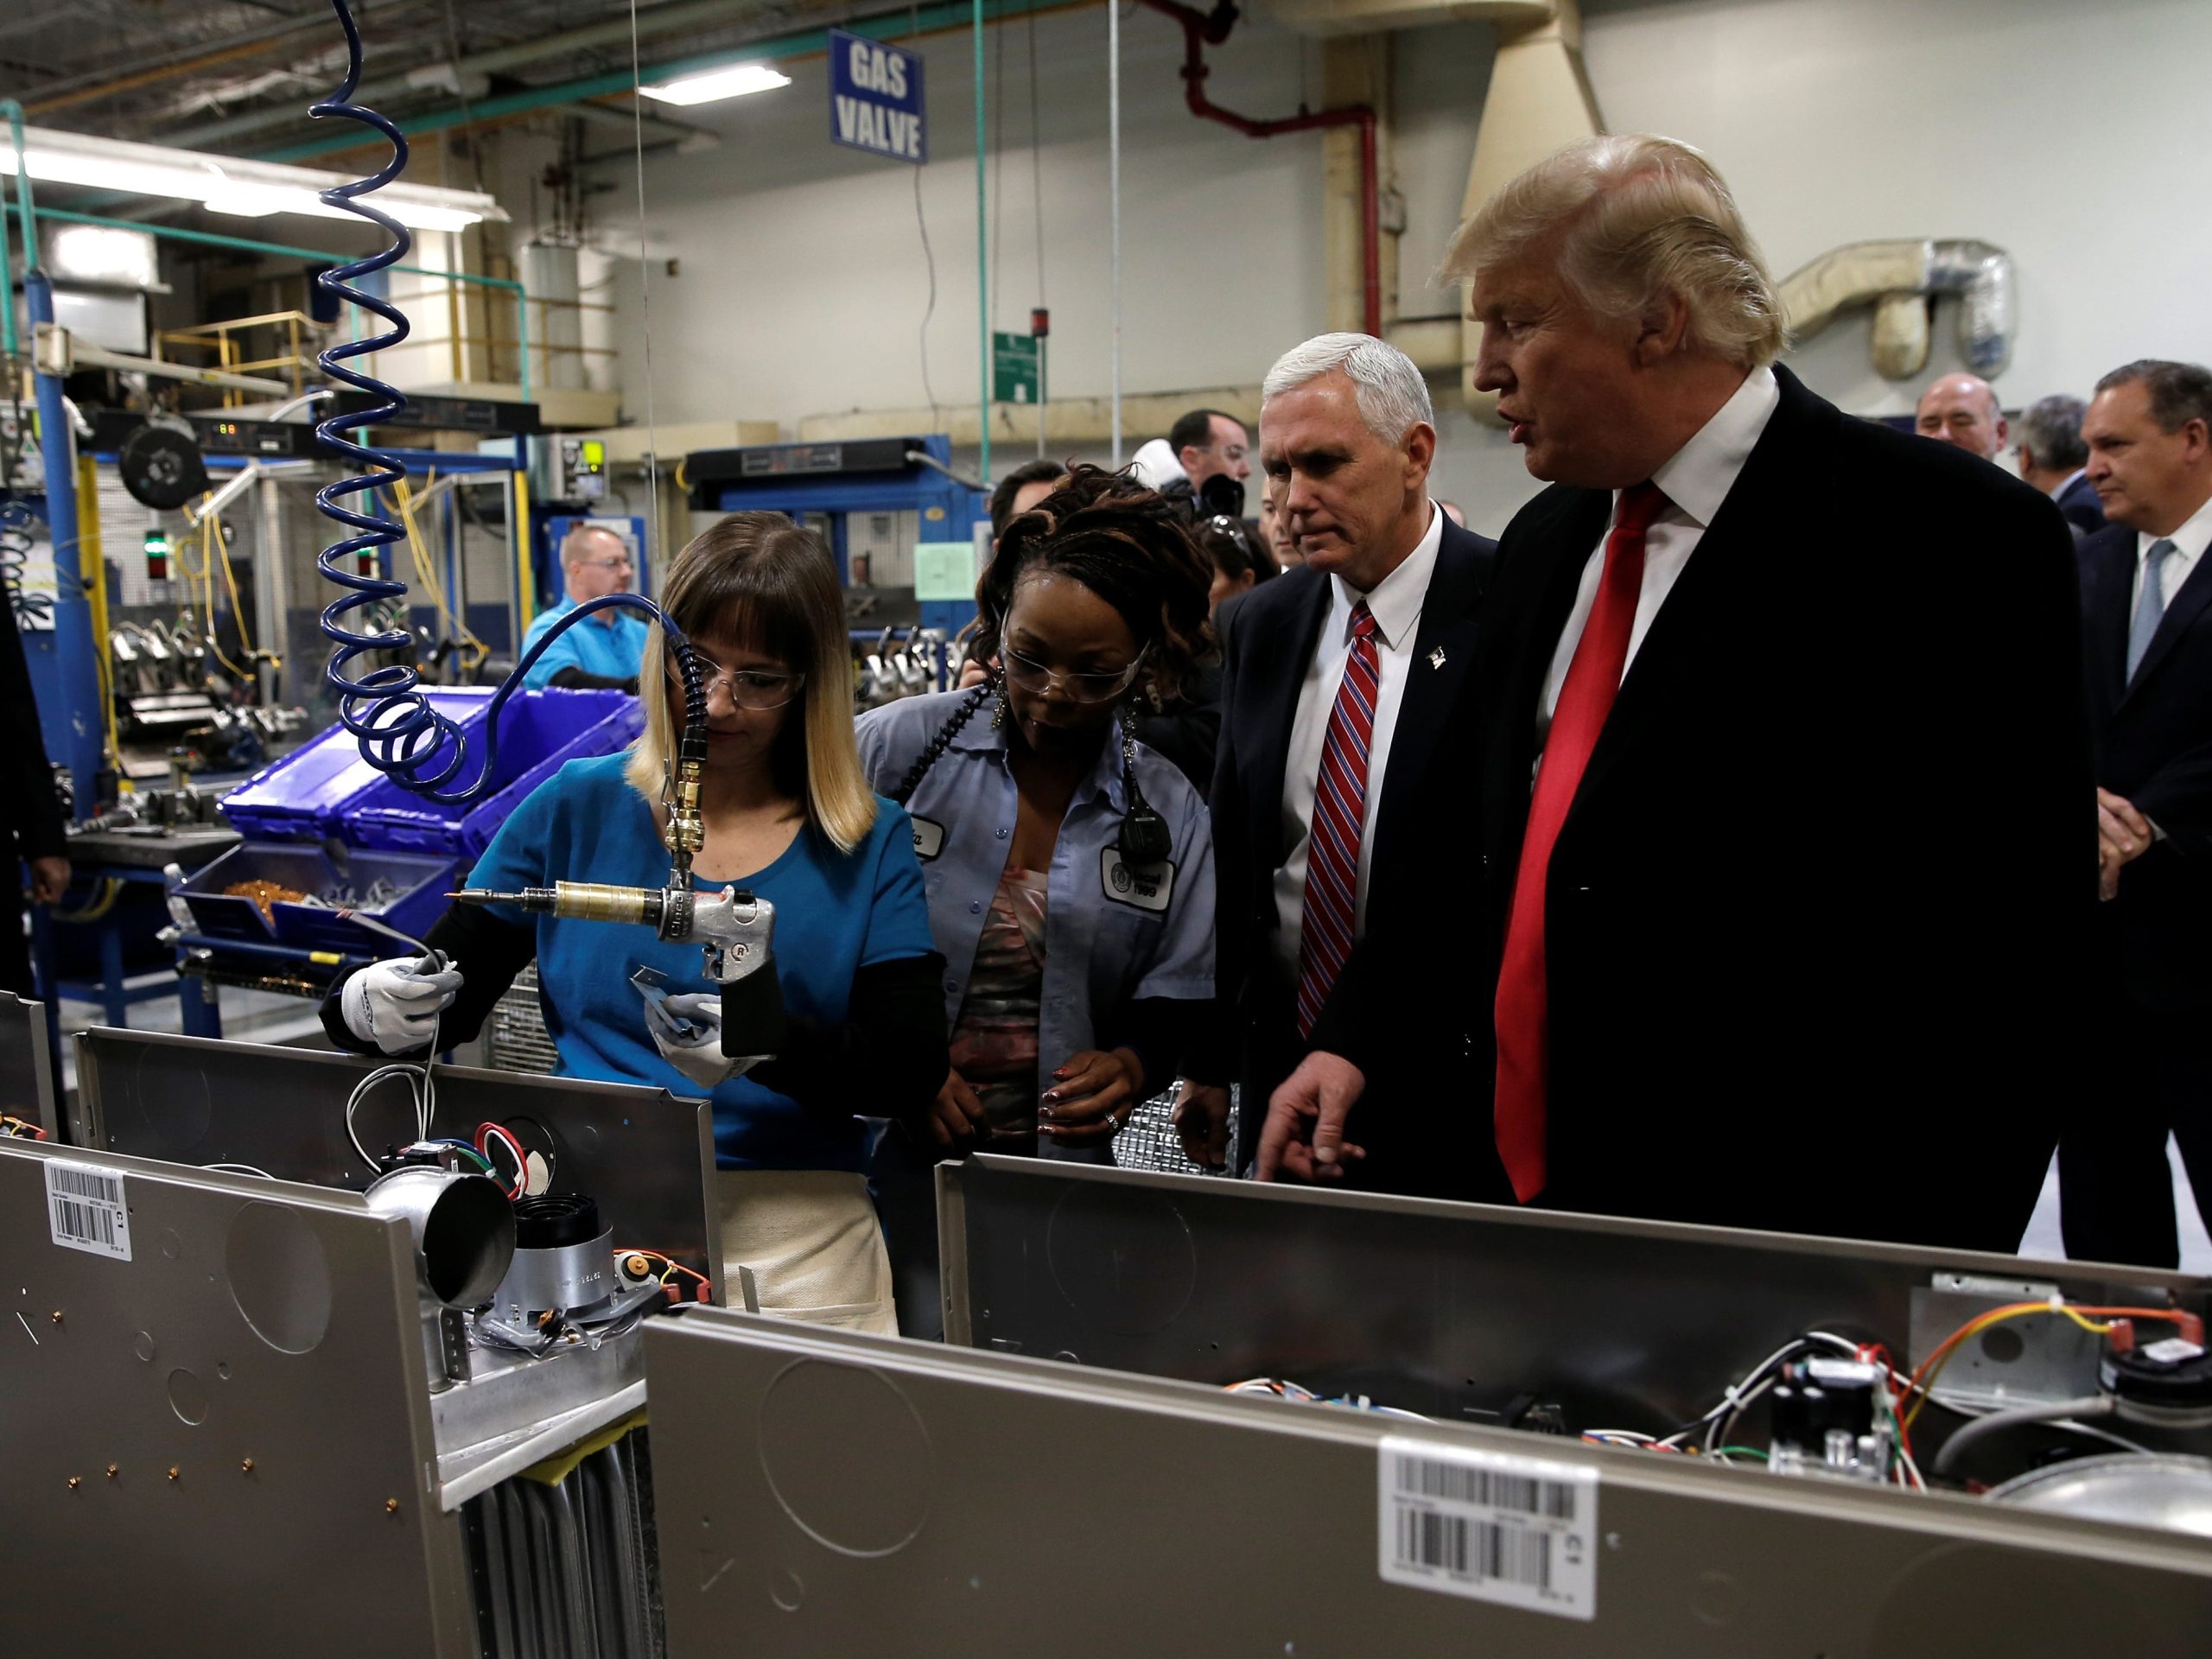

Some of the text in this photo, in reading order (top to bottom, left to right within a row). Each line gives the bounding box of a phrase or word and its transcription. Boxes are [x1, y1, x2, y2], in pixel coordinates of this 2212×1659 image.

[849, 40, 907, 99] GAS
[835, 94, 921, 158] VALVE
[116, 1211, 124, 1229] C1
